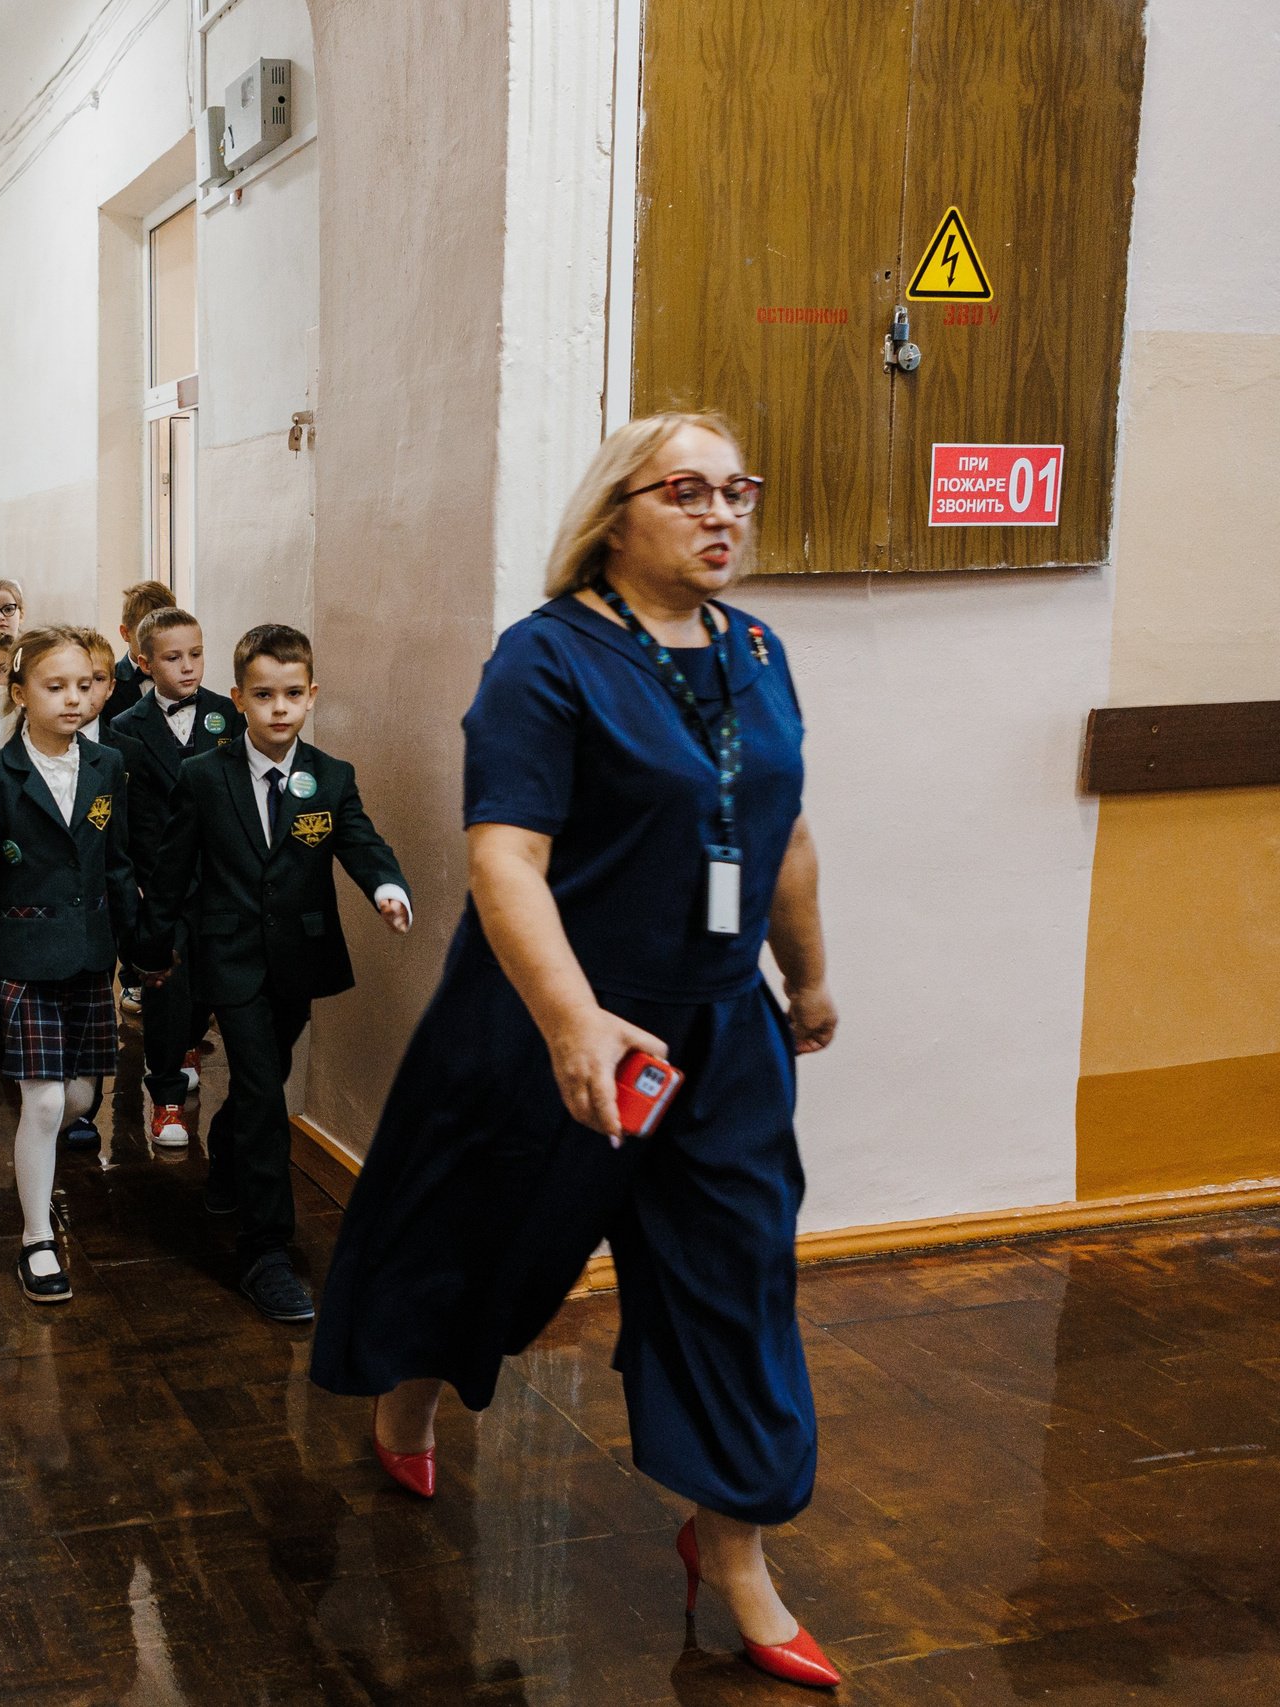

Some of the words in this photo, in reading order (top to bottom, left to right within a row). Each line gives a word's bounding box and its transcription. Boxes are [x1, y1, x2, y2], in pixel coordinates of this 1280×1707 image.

[757, 307, 849, 324] ОСТОРОЖНО
[943, 303, 984, 326] 380
[958, 457, 989, 471] ПРИ
[936, 478, 1006, 492] ПОЖАРЕ
[1008, 457, 1057, 513] 01
[936, 499, 1005, 513] ЗВОНИТЬ
